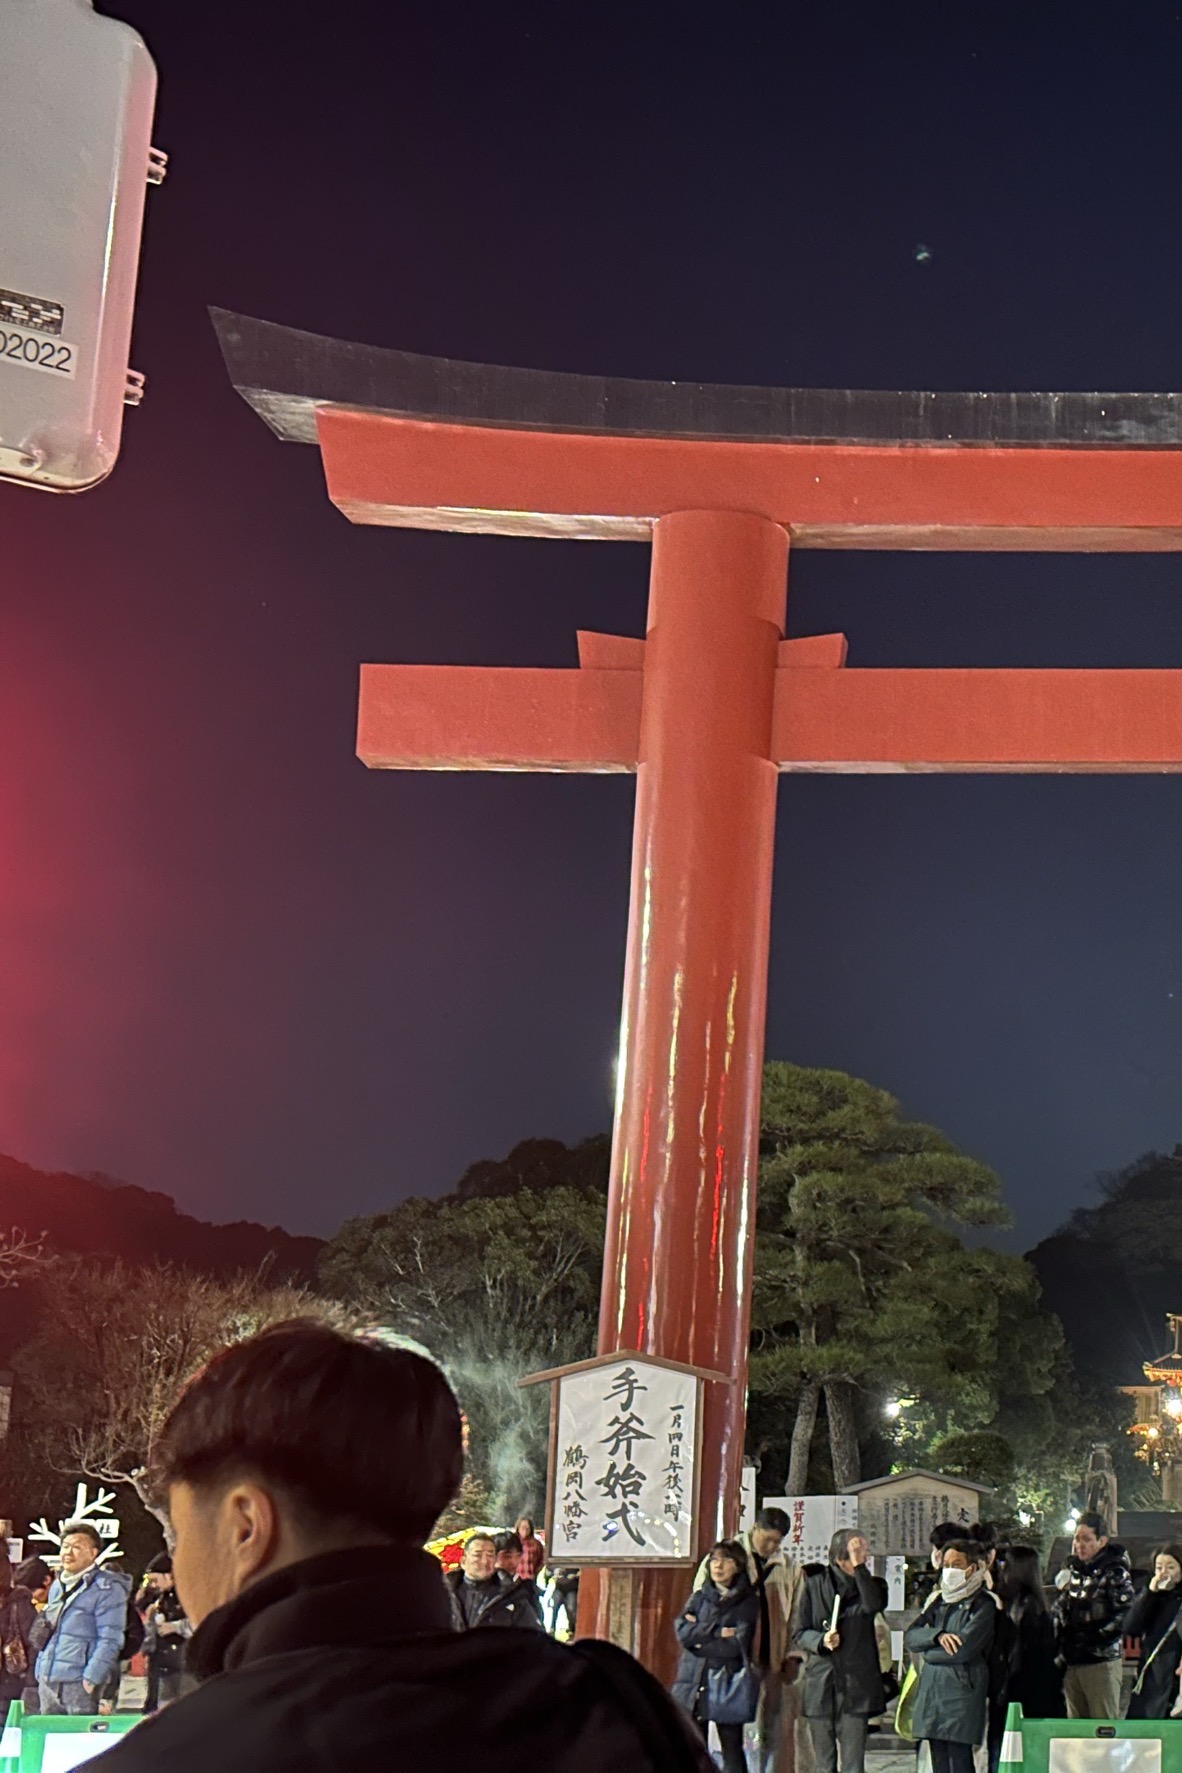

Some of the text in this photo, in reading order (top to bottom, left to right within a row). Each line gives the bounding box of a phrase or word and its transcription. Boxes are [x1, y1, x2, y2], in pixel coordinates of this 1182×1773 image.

[562, 1444, 588, 1542] 鶴岡八幡宮
[595, 1367, 656, 1547] 手斧始式
